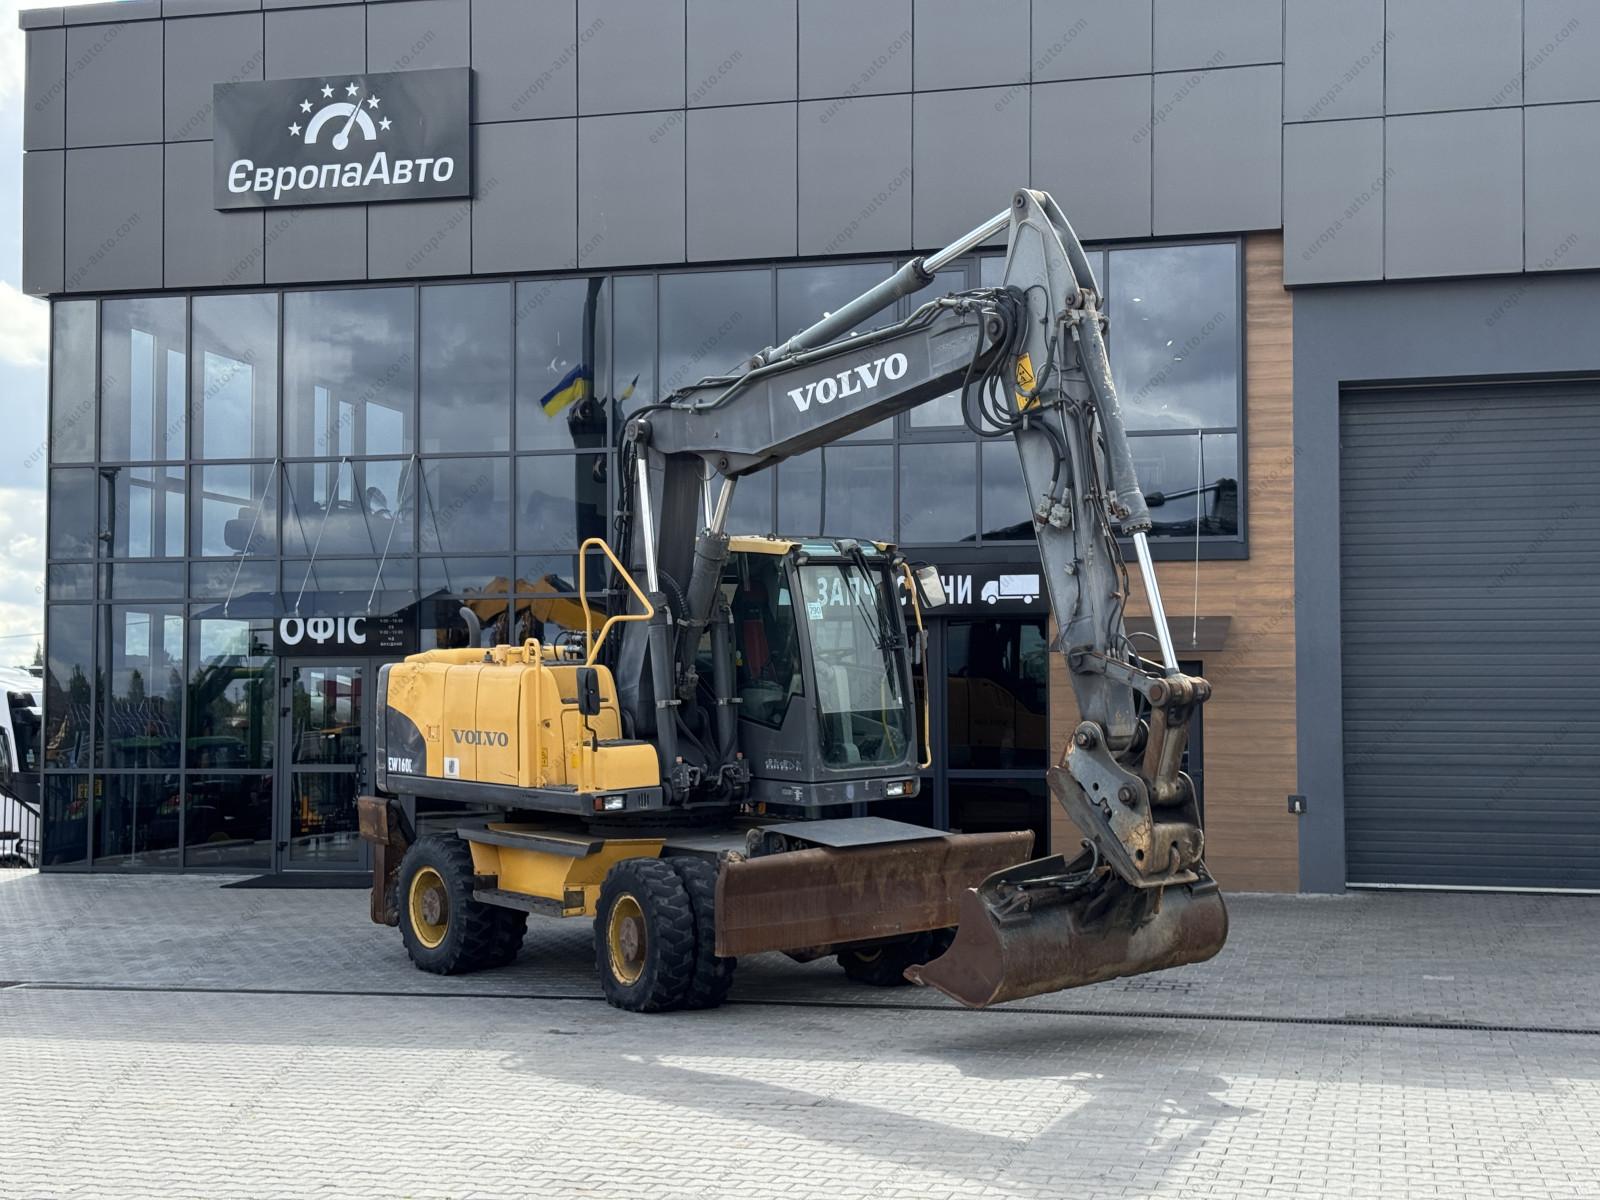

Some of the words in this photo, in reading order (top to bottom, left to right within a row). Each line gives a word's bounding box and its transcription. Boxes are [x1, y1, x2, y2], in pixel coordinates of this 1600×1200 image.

[227, 151, 455, 200] ЄвропаАвто
[787, 353, 908, 412] VOLVO
[816, 574, 972, 607] ЗАПЧСНИ
[279, 616, 367, 646] ОФІС
[451, 729, 509, 747] VOLVO
